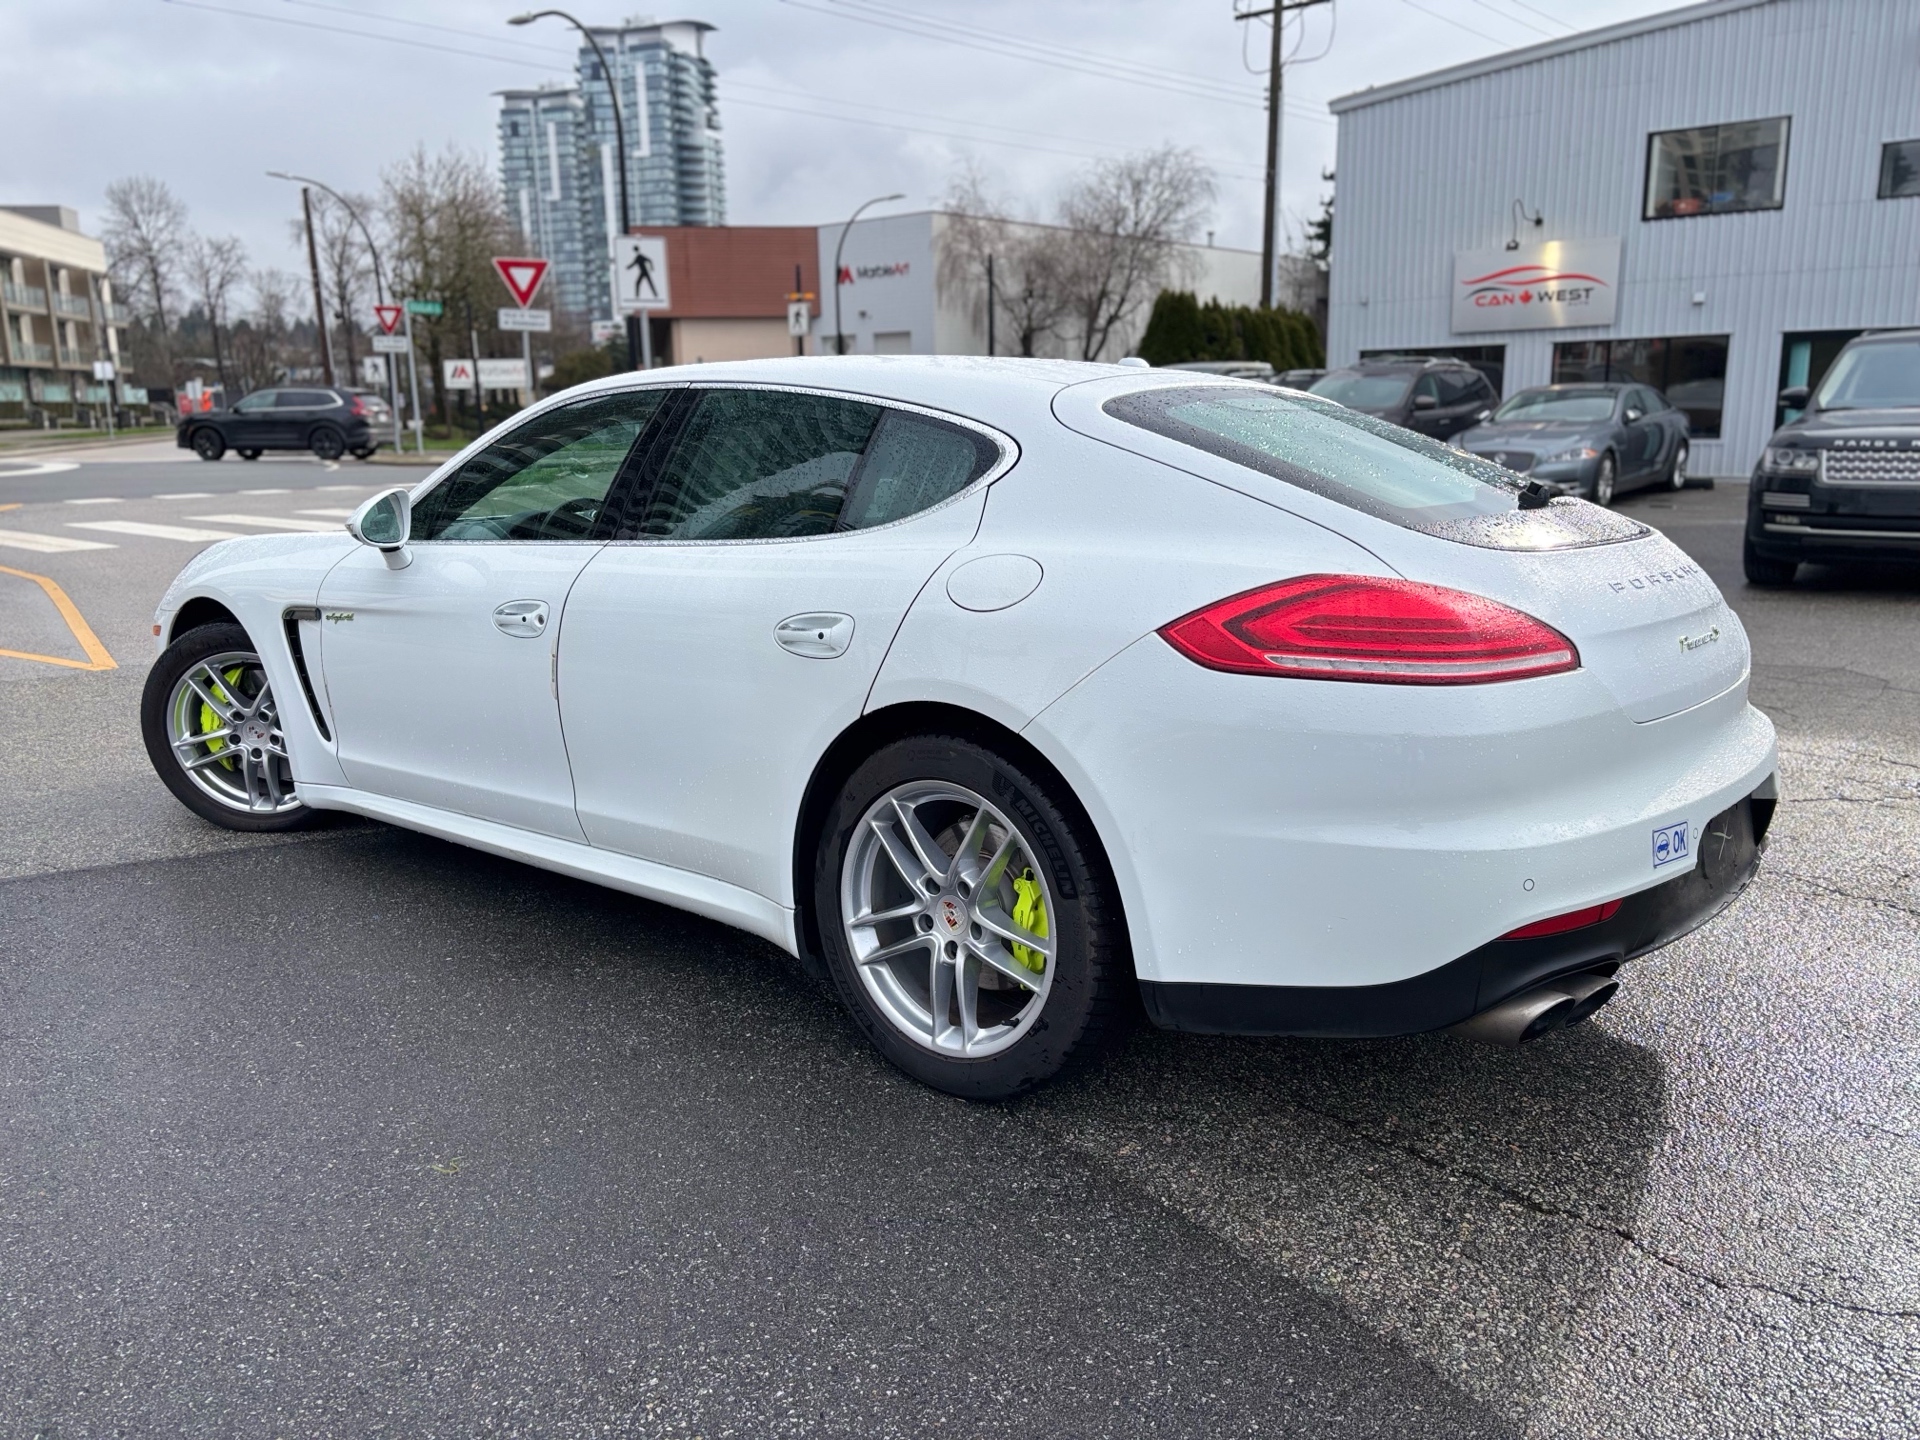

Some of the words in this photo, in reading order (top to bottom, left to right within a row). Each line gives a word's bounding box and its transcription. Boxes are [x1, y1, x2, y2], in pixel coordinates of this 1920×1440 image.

[1474, 293, 1516, 307] CAN
[1537, 287, 1595, 303] WEST
[1833, 439, 1898, 447] RANGE
[1015, 800, 1075, 897] MICHELIN
[1673, 828, 1687, 854] OK
